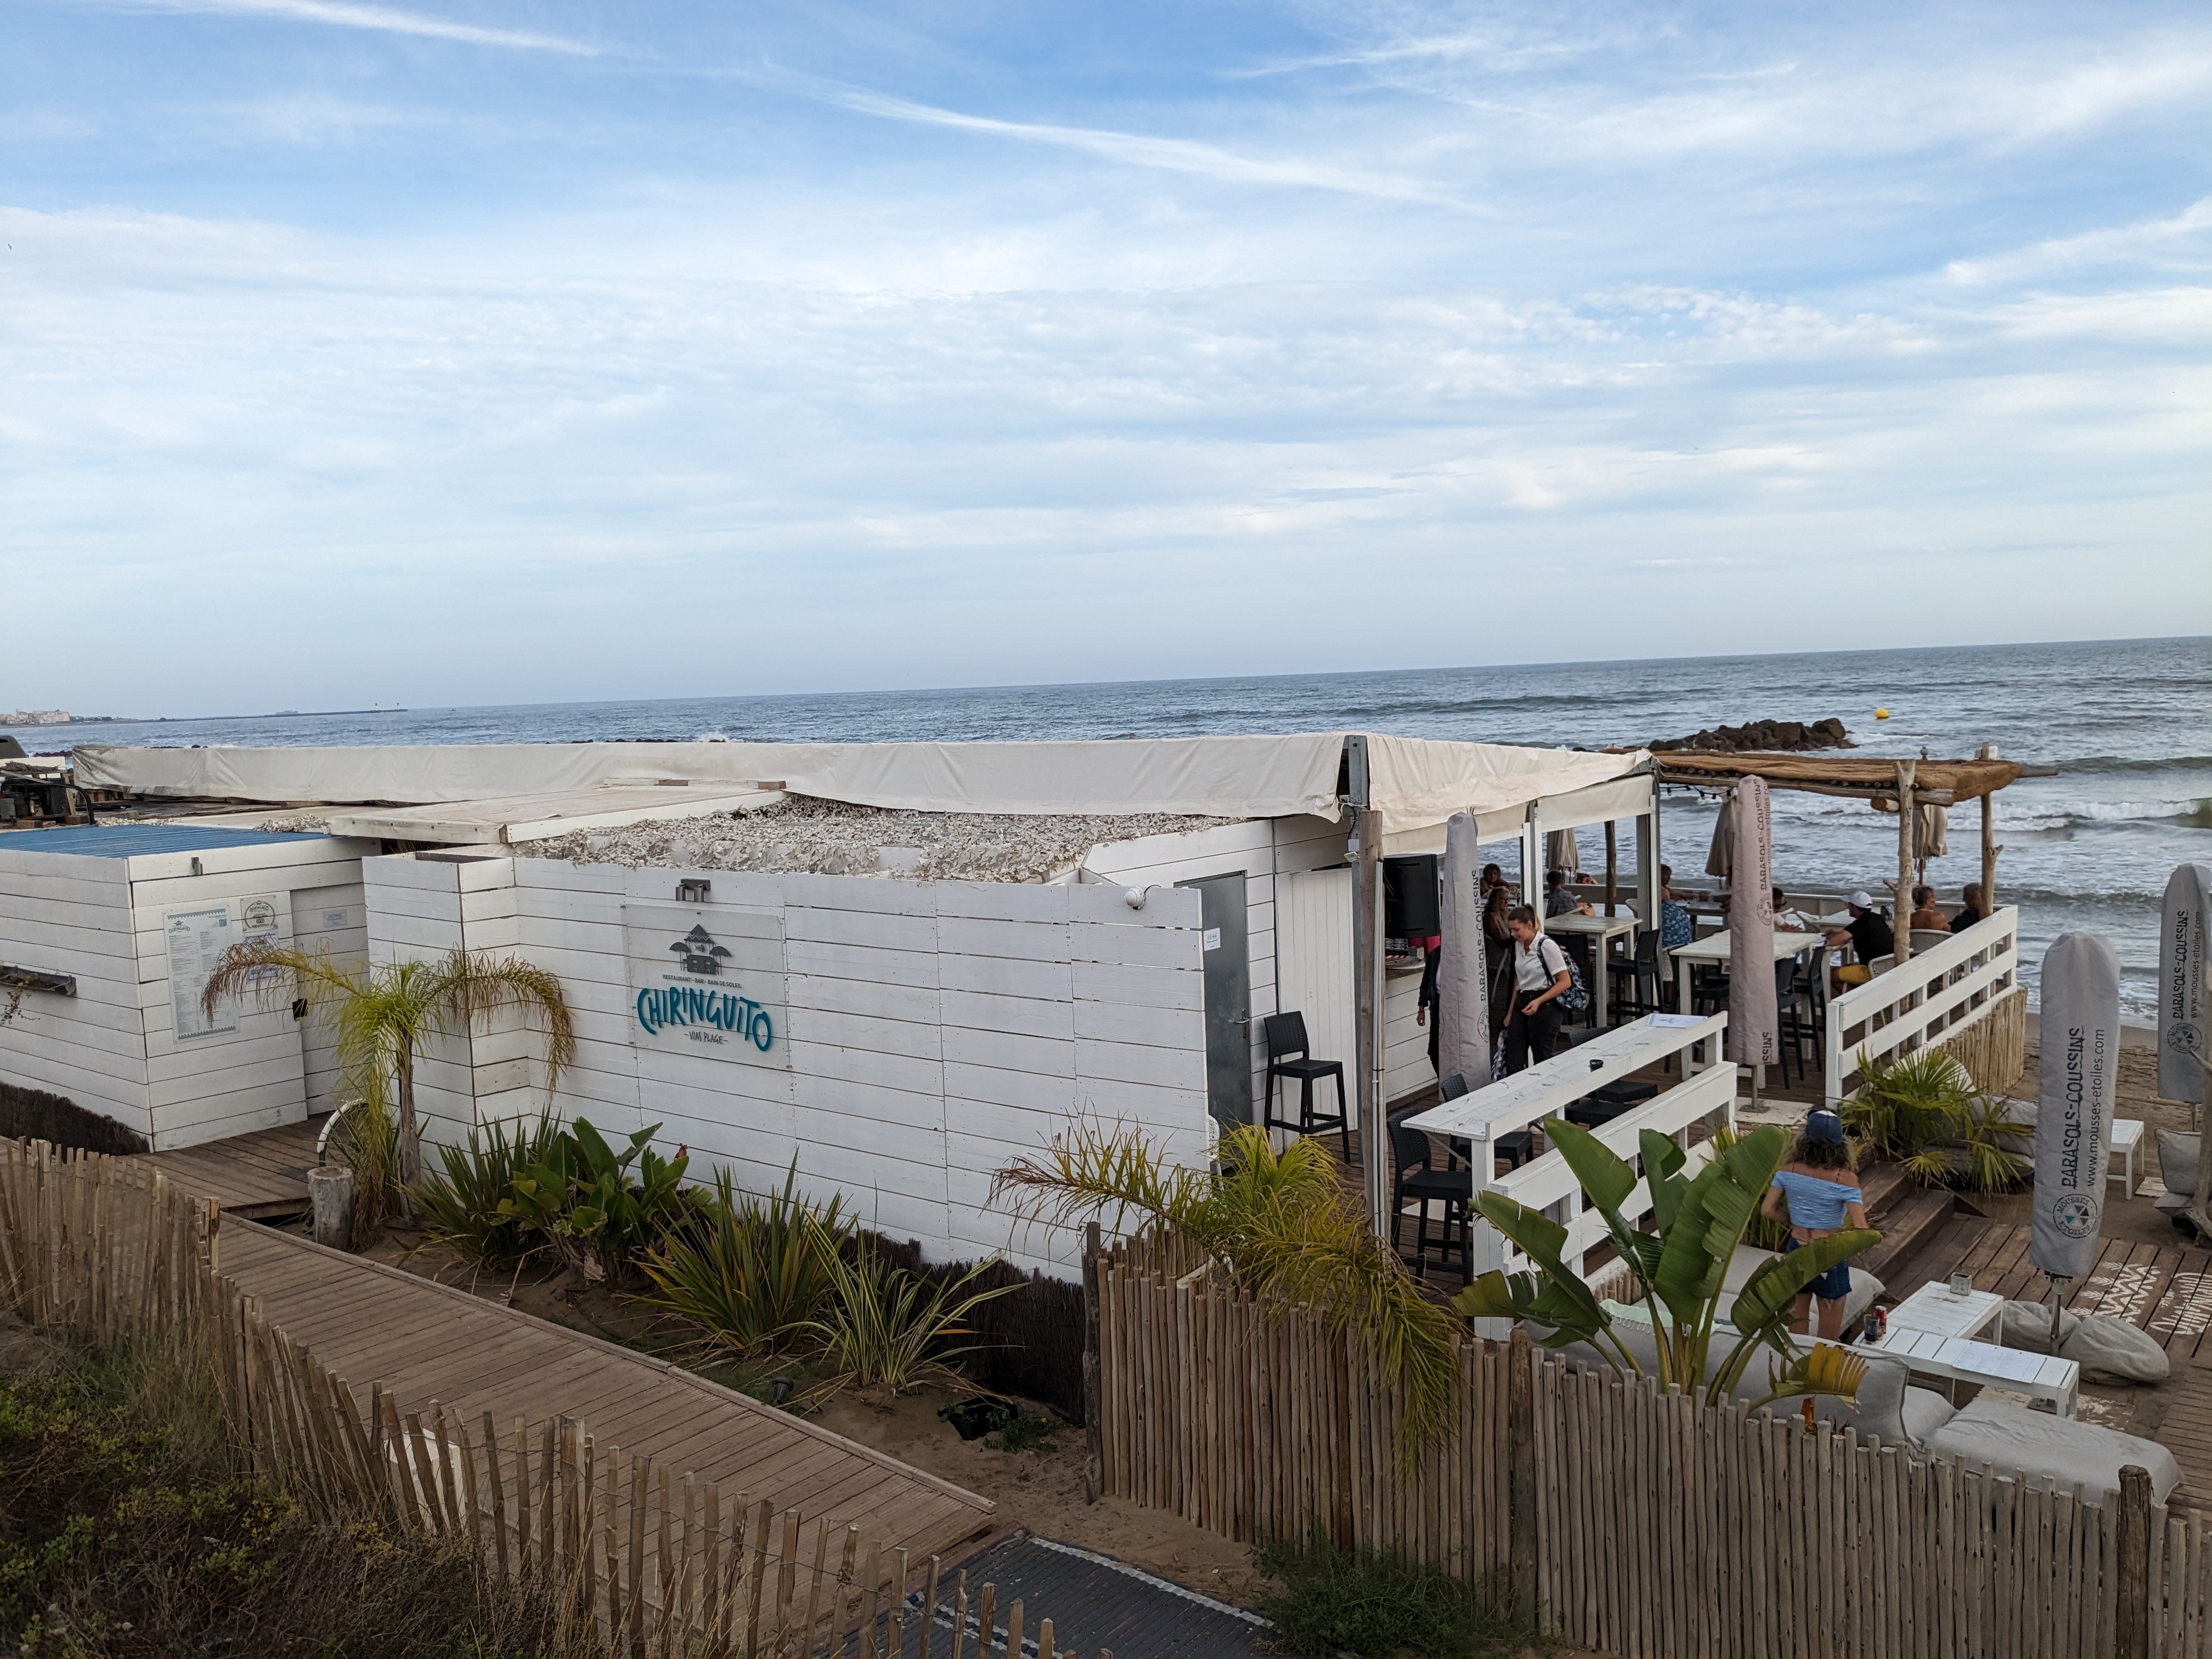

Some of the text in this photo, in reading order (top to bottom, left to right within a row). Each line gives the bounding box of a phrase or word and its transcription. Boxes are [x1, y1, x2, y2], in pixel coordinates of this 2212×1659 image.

[663, 974, 691, 982] RESTAURANT
[2172, 910, 2187, 1020] PARASOLS-COUSSINS
[2191, 911, 2201, 1019] www.mousses-etoiles.com
[637, 986, 771, 1051] CHIRINGUITO
[2061, 1027, 2084, 1188] PARASOLS-COUSSINS
[2087, 1029, 2104, 1187] www.mousses-etoiles.com
[2056, 1197, 2090, 1214] MOUSSES
[2058, 1221, 2091, 1235] ETOILES
